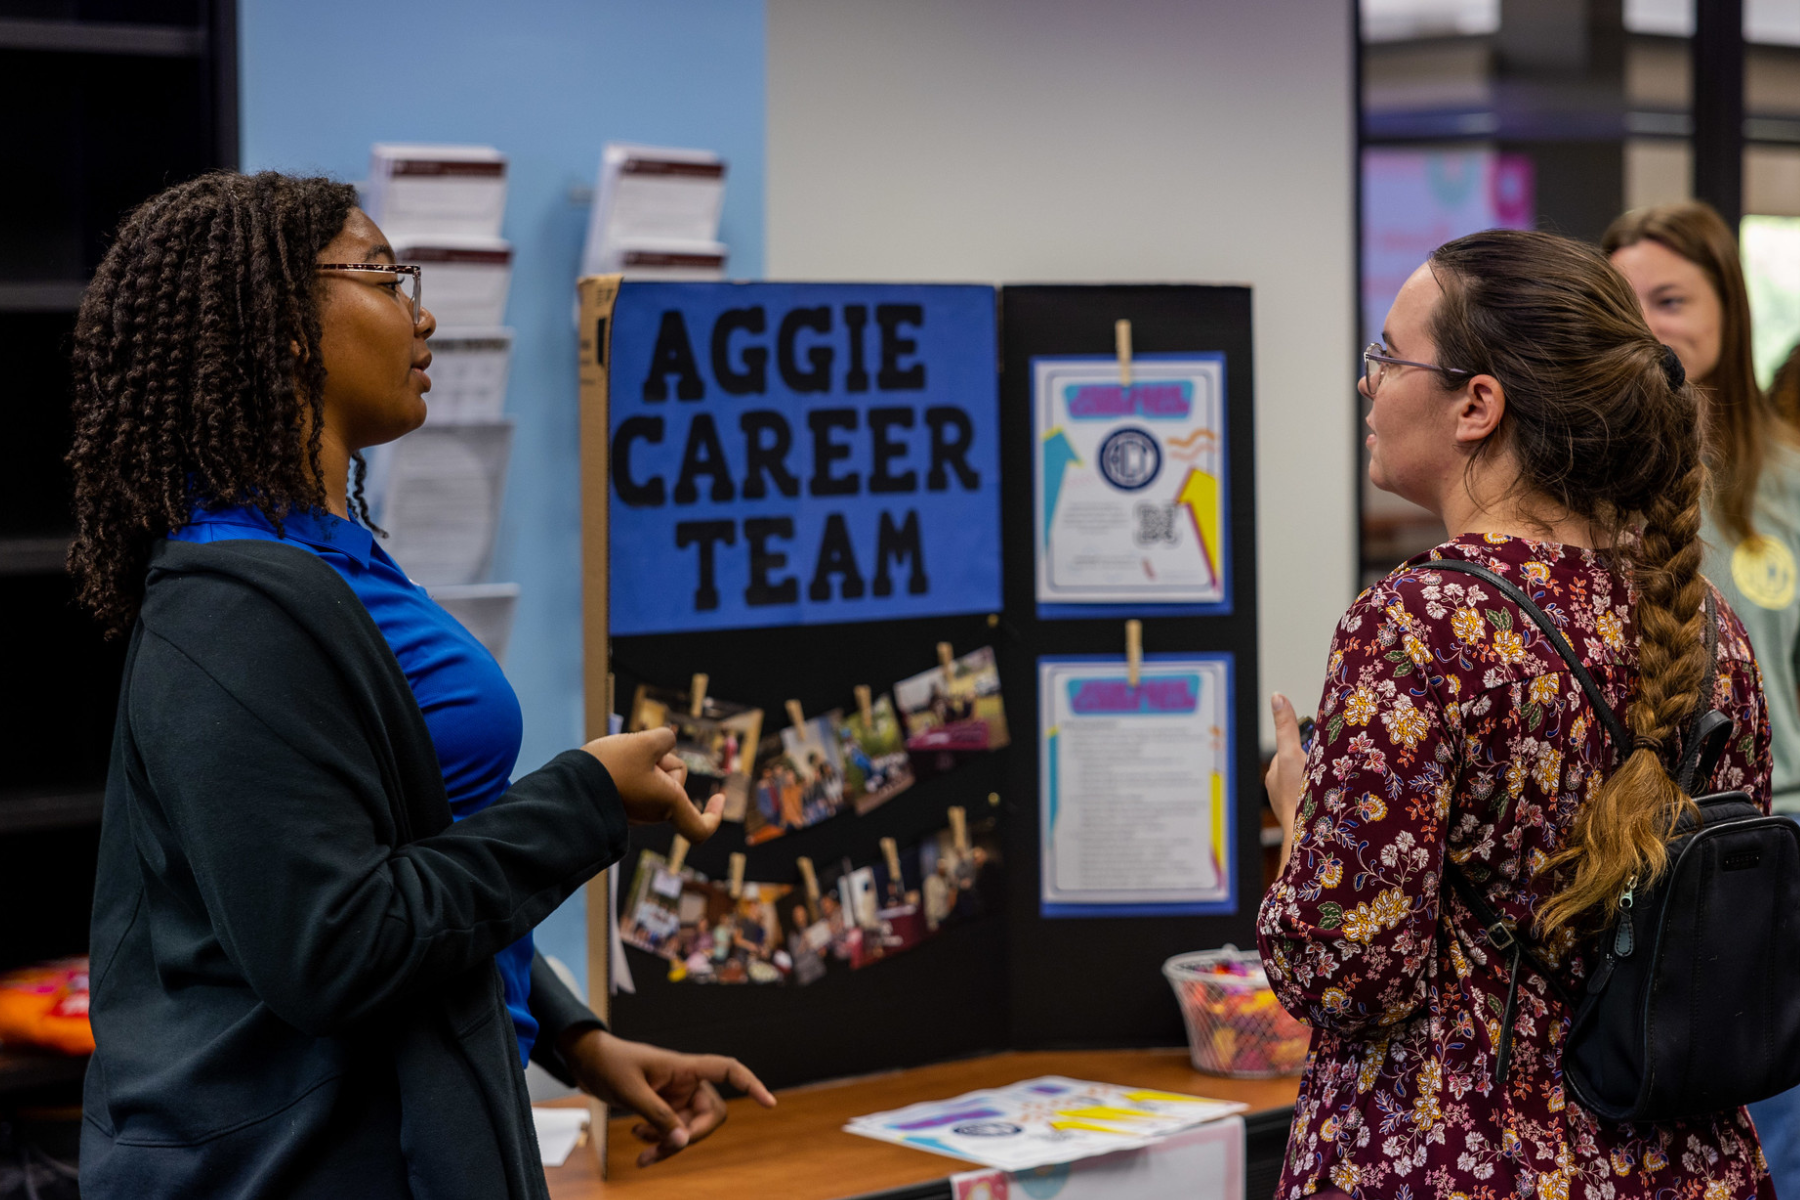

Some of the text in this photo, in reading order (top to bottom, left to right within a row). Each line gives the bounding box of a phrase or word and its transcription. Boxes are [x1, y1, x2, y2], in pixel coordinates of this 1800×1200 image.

[642, 304, 925, 403] AGGIE
[611, 406, 979, 508] CAREER
[675, 510, 929, 612] TEAM
